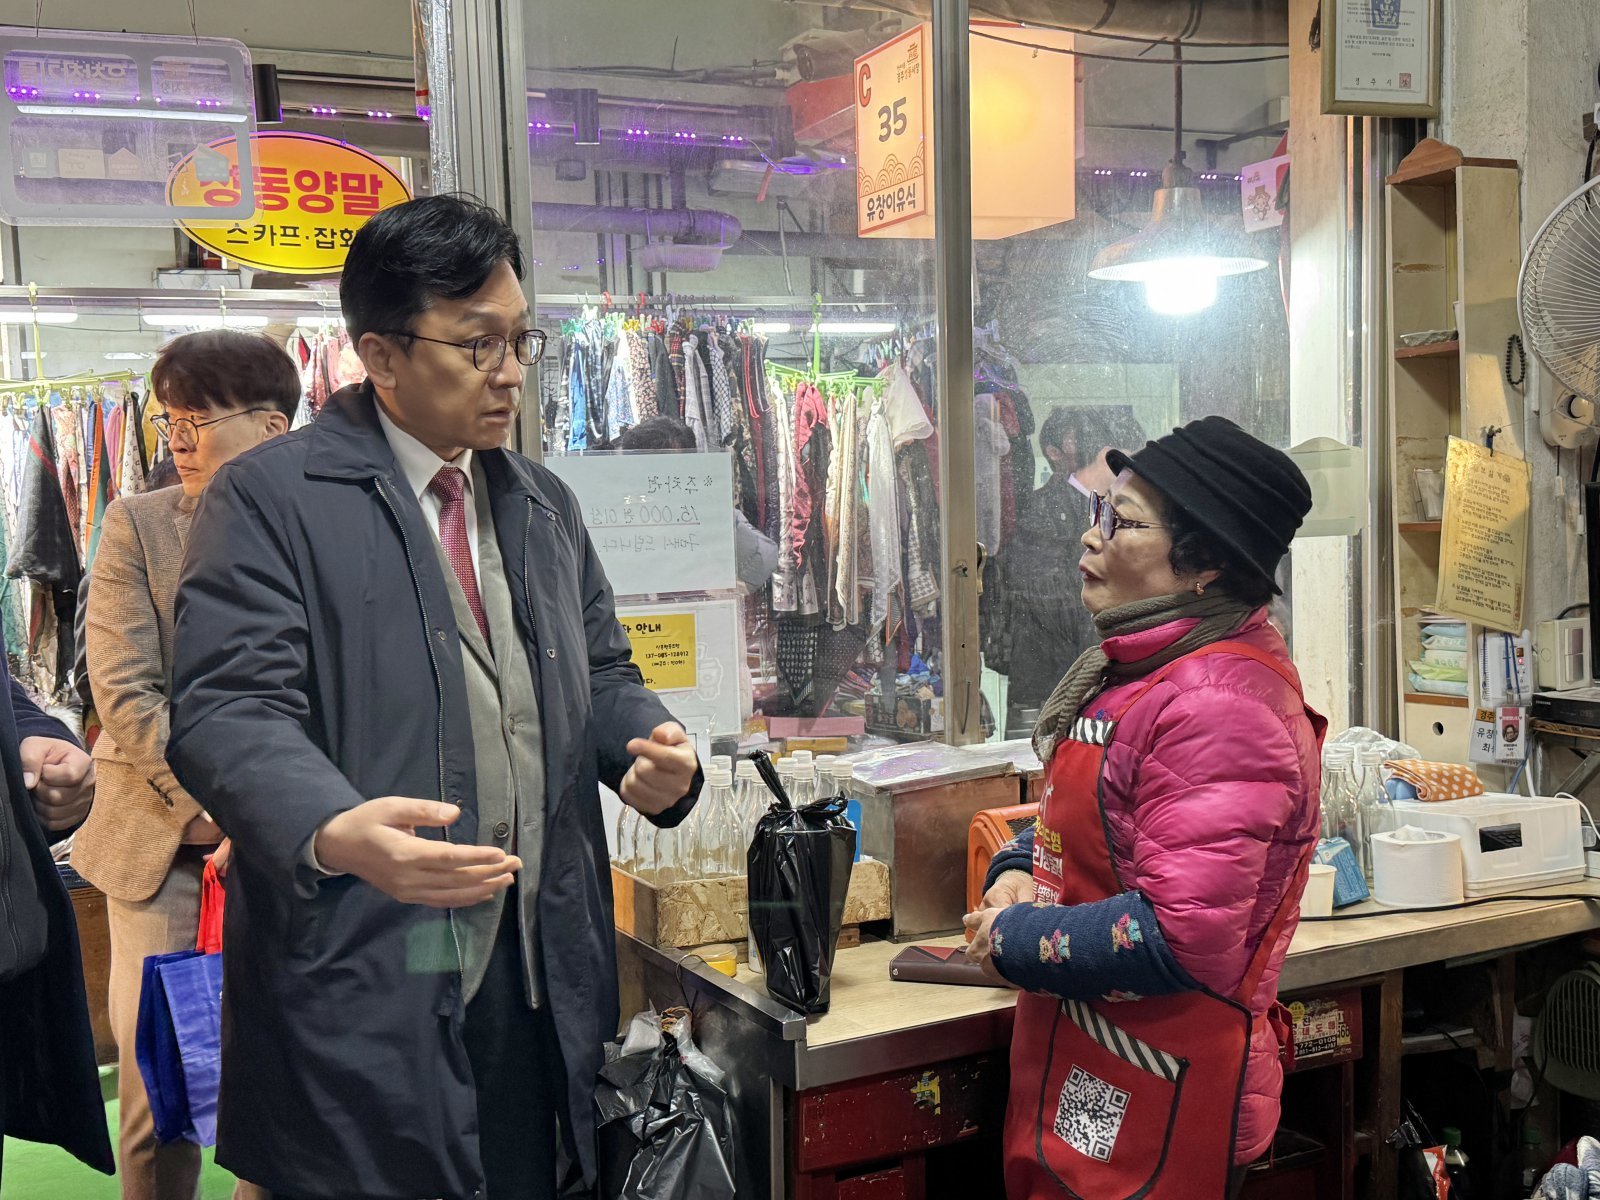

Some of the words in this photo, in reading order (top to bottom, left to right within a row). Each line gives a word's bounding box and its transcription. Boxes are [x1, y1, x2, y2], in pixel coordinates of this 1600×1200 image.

[858, 63, 872, 108] C
[878, 96, 907, 143] 35
[866, 182, 917, 223] 유창이유식
[635, 622, 662, 634] 안내
